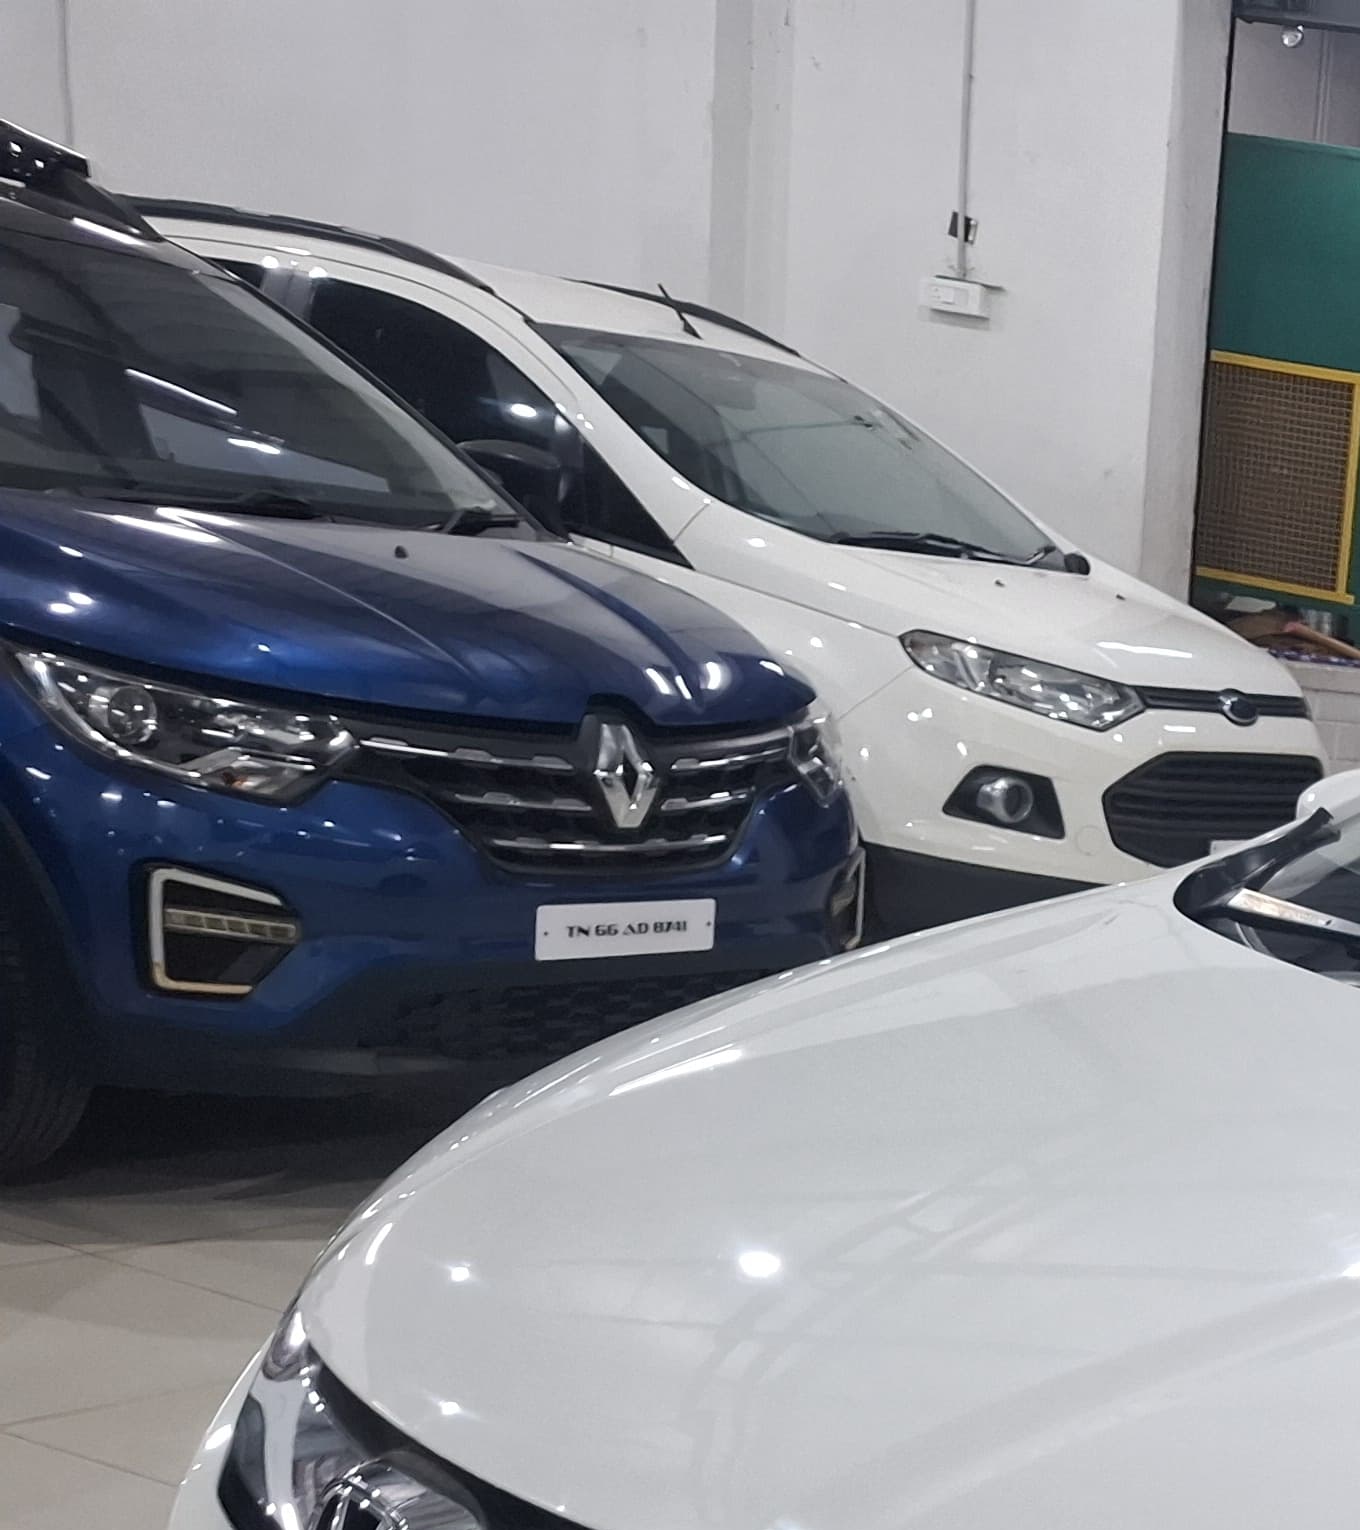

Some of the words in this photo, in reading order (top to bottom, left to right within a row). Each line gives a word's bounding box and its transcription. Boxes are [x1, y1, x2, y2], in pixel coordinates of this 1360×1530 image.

[566, 925, 591, 938] TN
[595, 923, 619, 937] 66
[622, 922, 649, 936] AD
